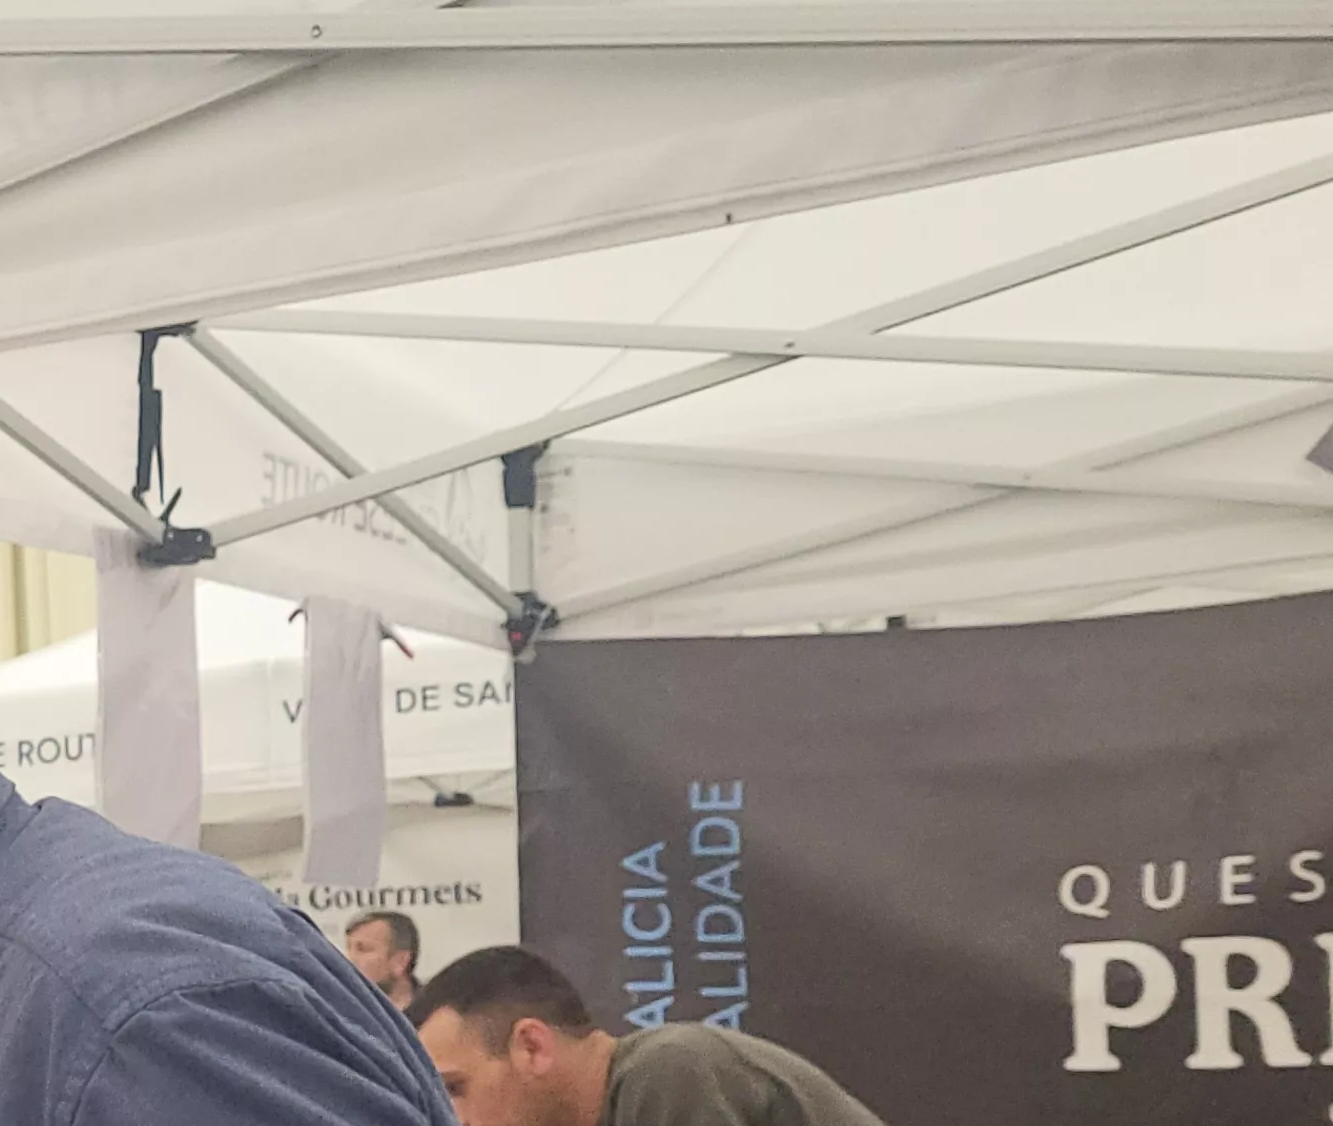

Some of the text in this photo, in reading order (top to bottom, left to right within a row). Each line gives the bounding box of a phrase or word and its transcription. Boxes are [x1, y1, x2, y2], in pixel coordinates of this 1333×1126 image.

[395, 685, 440, 713] DE
[17, 732, 96, 768] ROUT
[308, 880, 484, 911] Gourmets
[690, 780, 749, 1030] ALIDADE
[1058, 850, 1327, 919] QUES
[620, 840, 675, 1030] ALICIA
